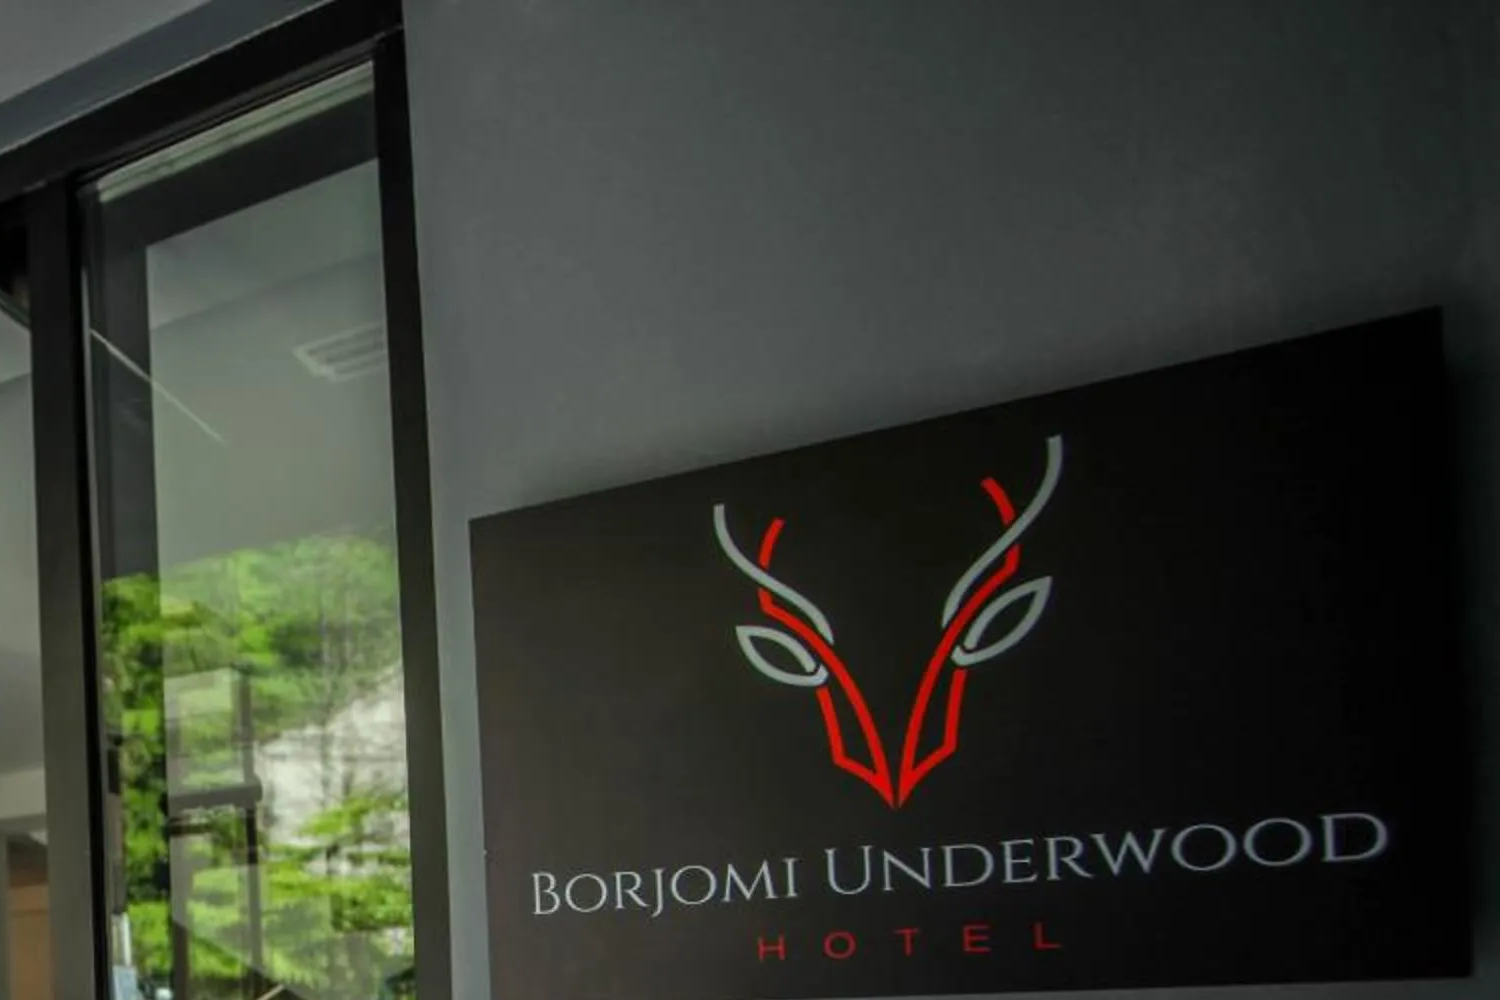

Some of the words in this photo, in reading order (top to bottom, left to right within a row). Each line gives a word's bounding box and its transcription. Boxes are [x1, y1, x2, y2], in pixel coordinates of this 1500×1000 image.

[531, 857, 798, 918] BORJOMI
[824, 811, 1389, 895] UNDERWOOD
[757, 922, 1063, 962] HOTEL
